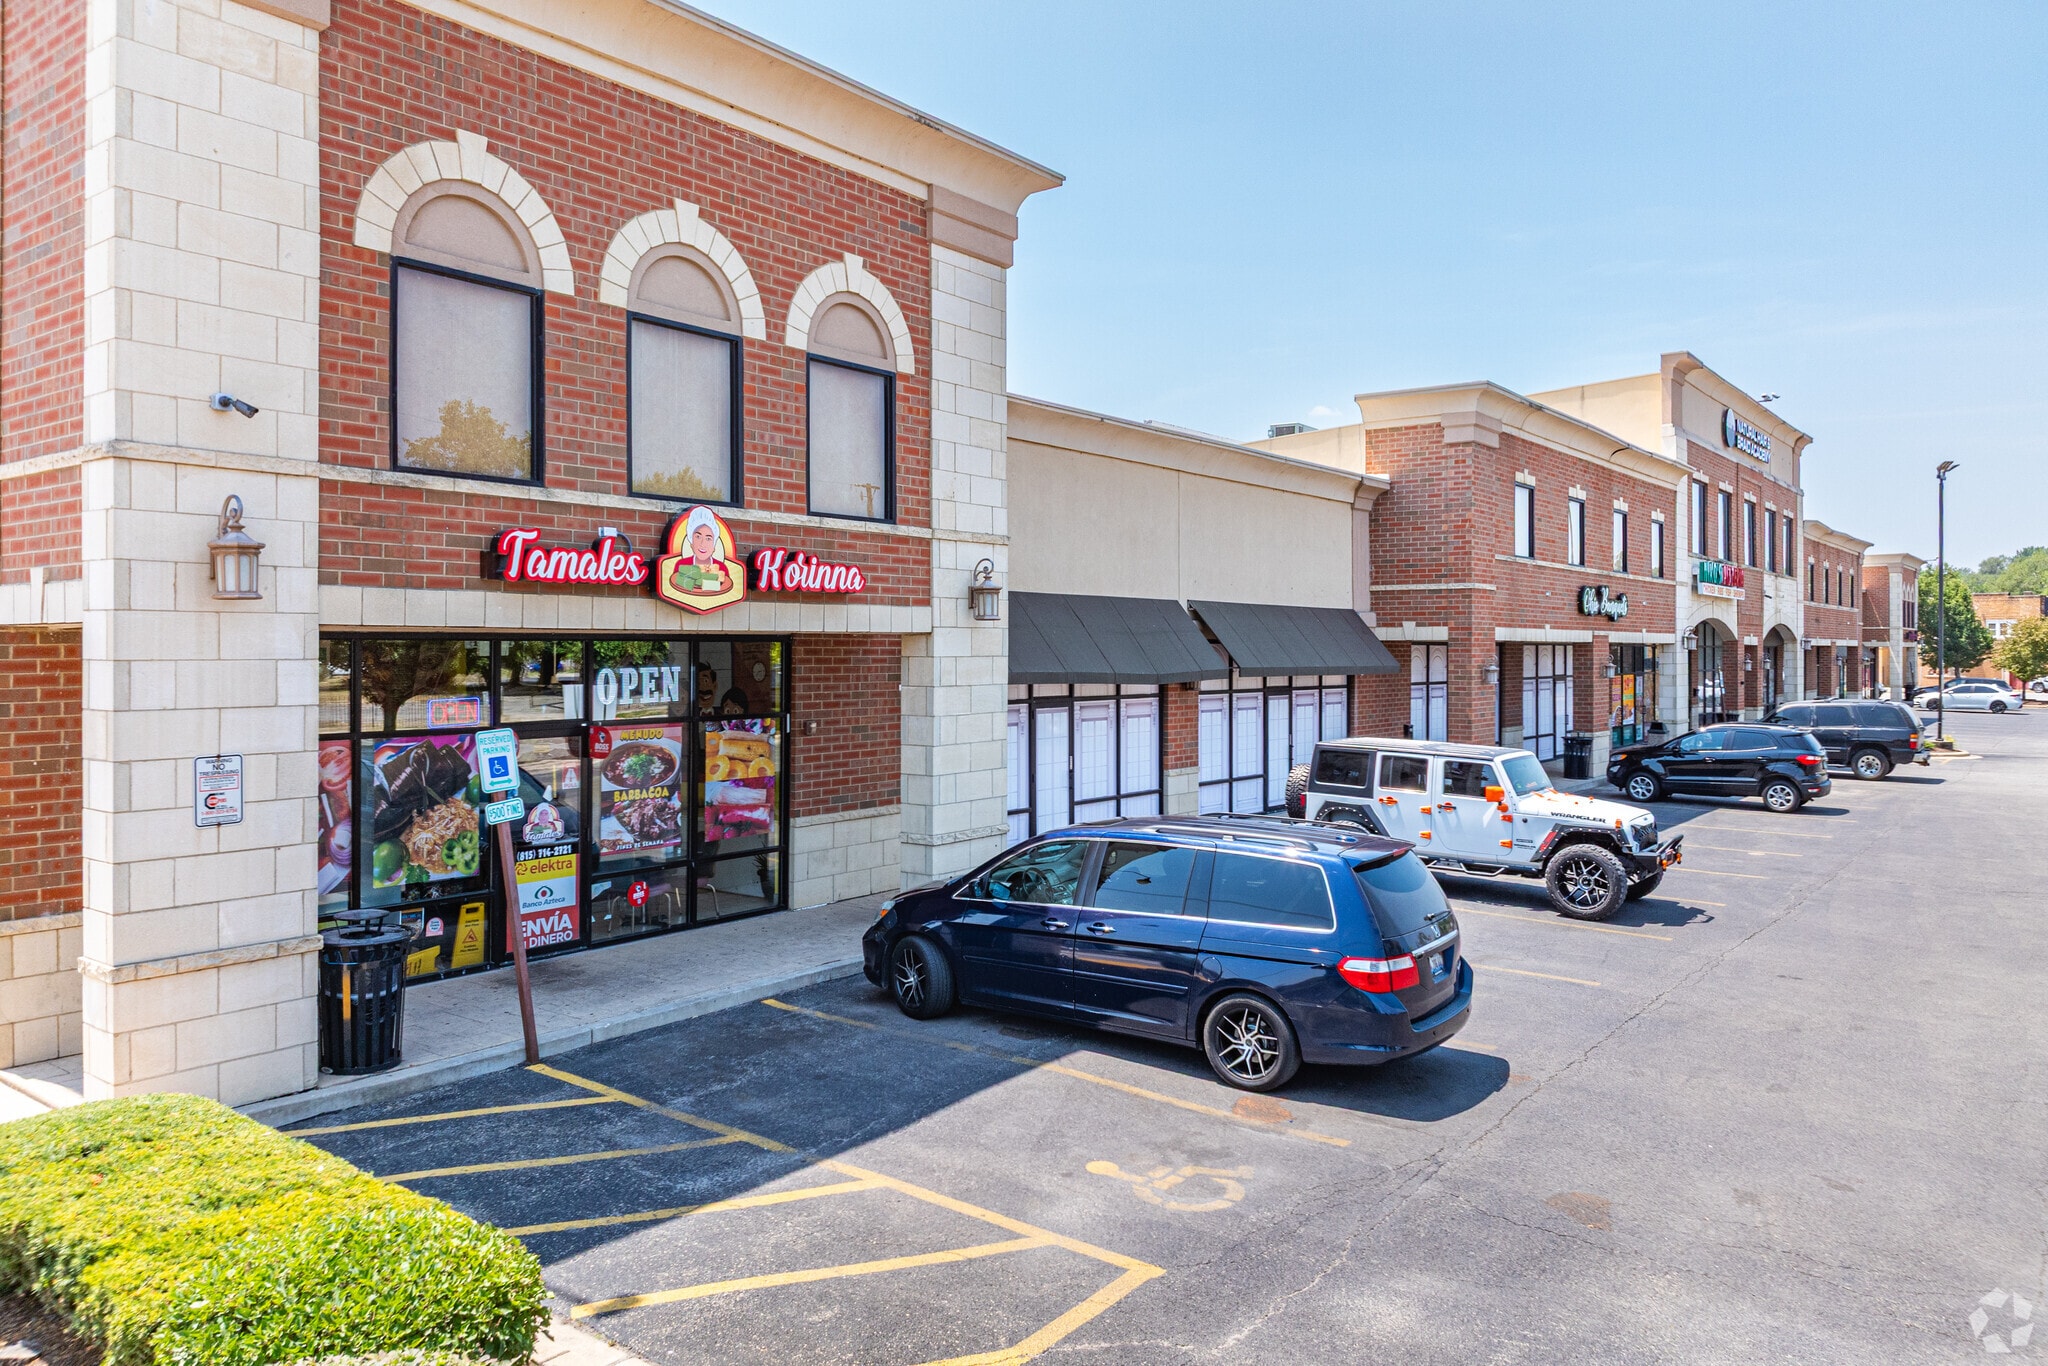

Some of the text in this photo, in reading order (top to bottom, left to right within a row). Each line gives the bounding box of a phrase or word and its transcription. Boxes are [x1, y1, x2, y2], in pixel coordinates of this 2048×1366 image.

[500, 529, 866, 592] Tamales Korinna
[597, 666, 681, 704] OPEN
[431, 701, 478, 724] OPEN
[479, 734, 512, 746] RESERVED
[620, 728, 663, 741] MENUDO
[482, 745, 511, 755] PARKING
[212, 763, 226, 771] NO
[613, 786, 669, 803] BARBACOA
[489, 802, 522, 820] $500 FINE
[1550, 811, 1606, 823] WRANGLER
[516, 849, 537, 862] (815)
[530, 859, 573, 875] elektra
[522, 897, 566, 909] Banco Azteca
[529, 930, 573, 949] DINERO
